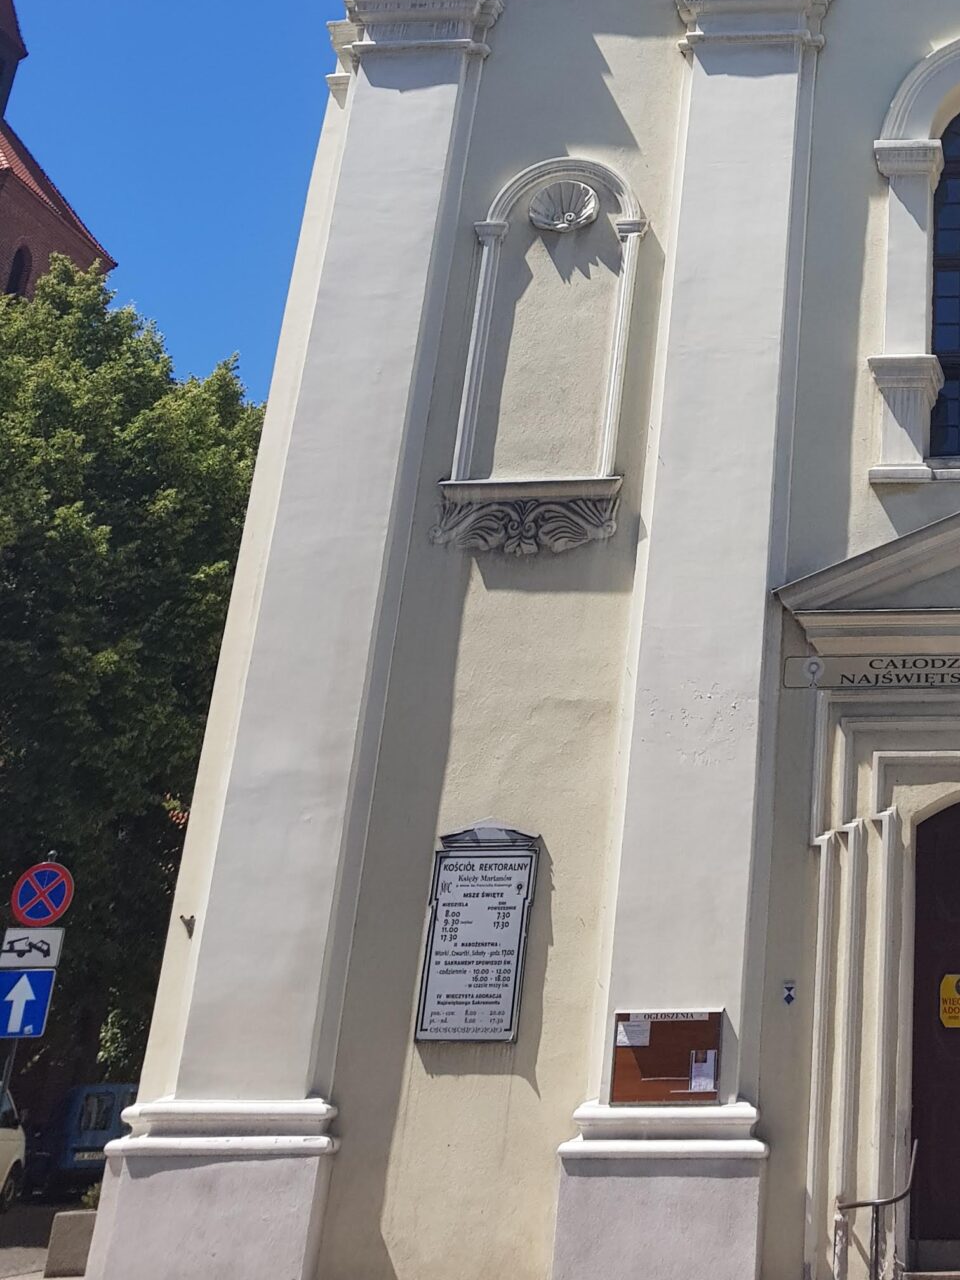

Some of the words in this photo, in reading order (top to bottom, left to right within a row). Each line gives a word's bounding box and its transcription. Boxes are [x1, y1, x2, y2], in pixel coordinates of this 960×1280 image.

[443, 861, 475, 872] KOŚCIÓŁ
[478, 862, 529, 872] REKTORALNY
[444, 909, 461, 918] 8.00
[496, 911, 511, 920] 7.30
[443, 918, 460, 927] 9.30
[493, 921, 510, 930] 17.30
[440, 933, 458, 942] 17.30
[643, 1012, 694, 1020] OGŁOSZENIA
